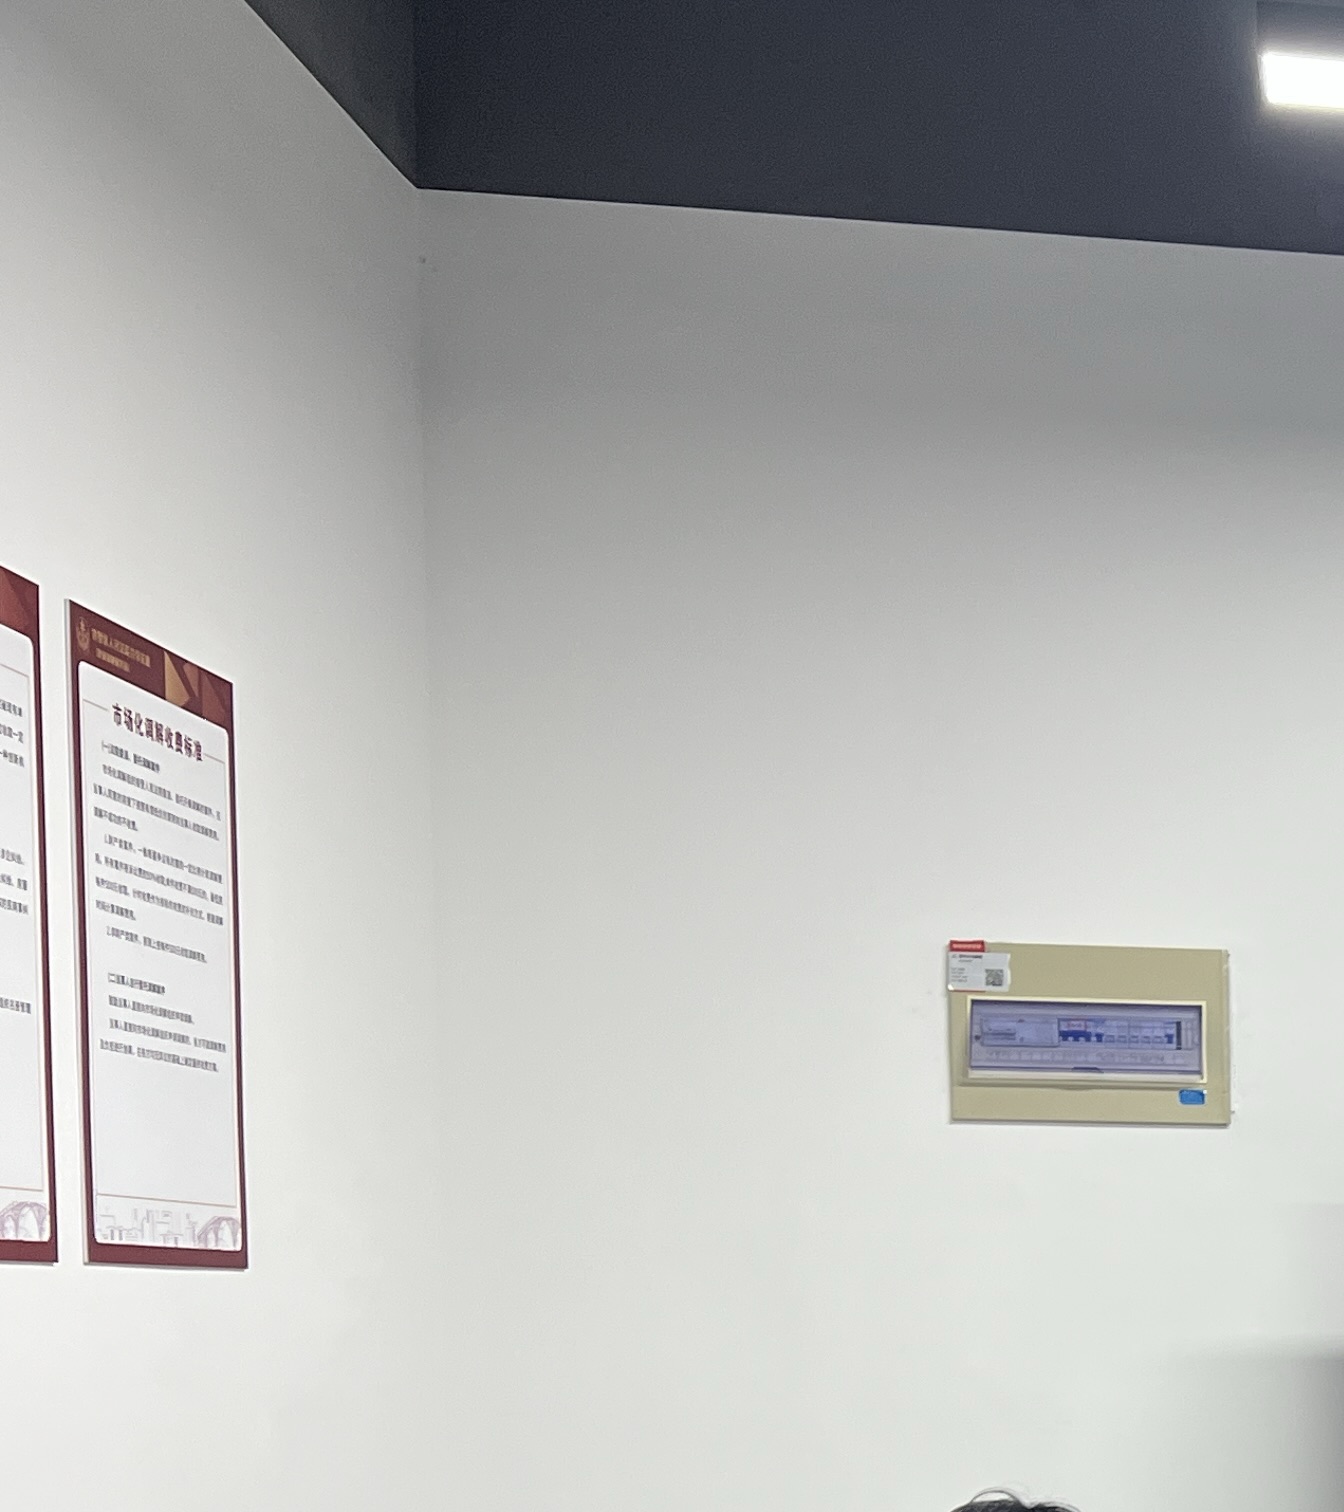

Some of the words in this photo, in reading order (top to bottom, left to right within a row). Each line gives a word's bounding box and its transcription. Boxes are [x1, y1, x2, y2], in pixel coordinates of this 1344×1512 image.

[112, 702, 203, 762] 市场化调解收费标准
